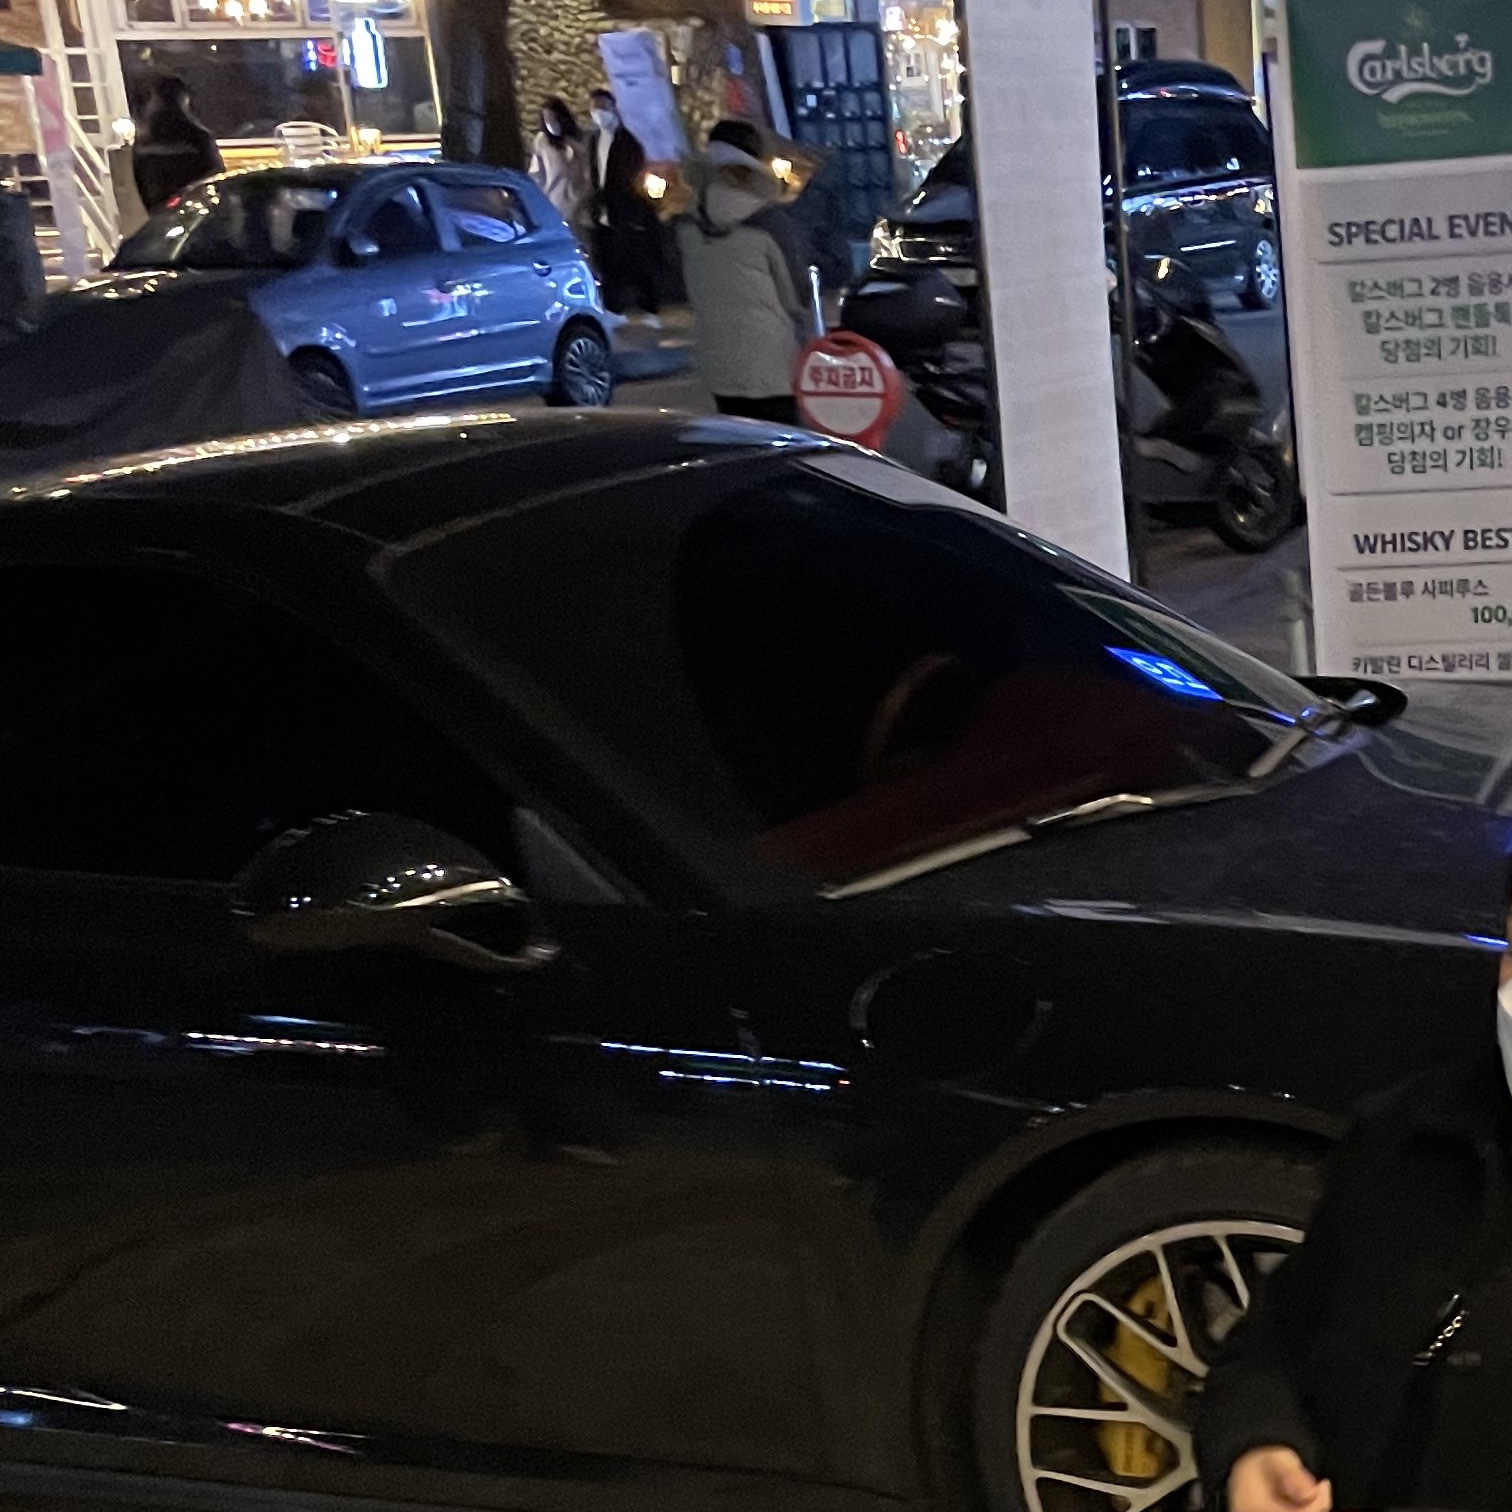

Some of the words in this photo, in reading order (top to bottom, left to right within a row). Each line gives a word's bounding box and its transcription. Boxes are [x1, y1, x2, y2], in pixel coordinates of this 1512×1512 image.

[1346, 32, 1493, 104] Carlsberg
[1327, 216, 1441, 247] SPECIAL
[1349, 277, 1425, 303] 칼스버그
[1362, 307, 1446, 335] 칼스버그
[1380, 335, 1442, 363] 당첨의
[808, 365, 875, 389] 주차금지
[1354, 391, 1430, 416] 칼스버그
[1355, 420, 1435, 447] 캠핑의자
[1443, 424, 1465, 441] or
[1387, 448, 1448, 475] 당첨의
[1455, 446, 1503, 471] 기회!
[1353, 529, 1455, 554] WHISKY
